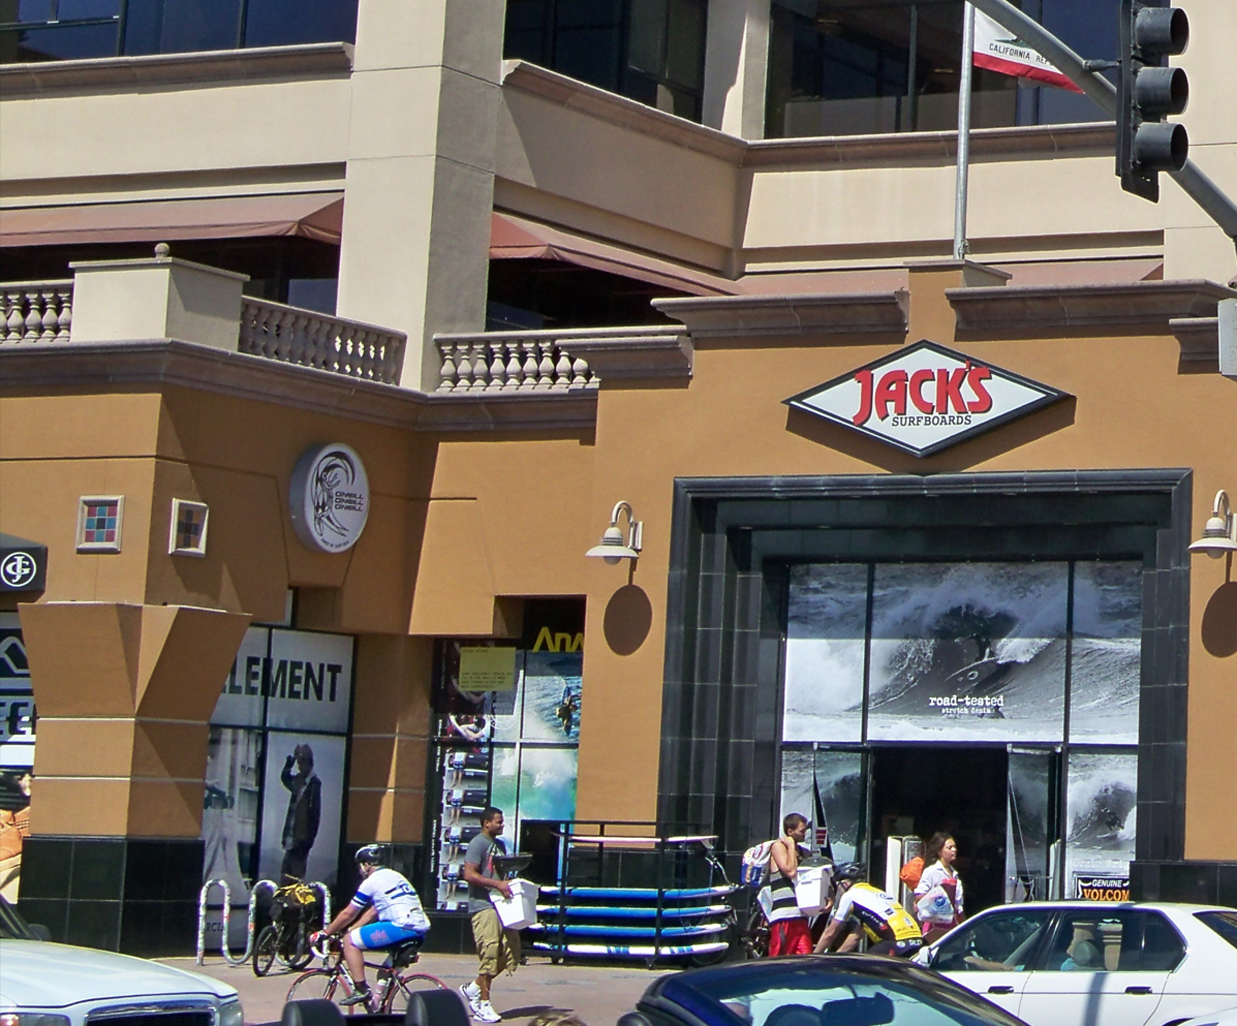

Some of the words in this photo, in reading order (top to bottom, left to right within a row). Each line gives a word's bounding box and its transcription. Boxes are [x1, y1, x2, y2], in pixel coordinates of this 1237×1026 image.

[989, 43, 1030, 60] CALIFORNIA
[852, 360, 994, 427] JACK'S
[892, 415, 972, 427] SURFBOARDS
[221, 655, 342, 703] LEMENT
[929, 695, 1004, 707] road-tested
[1092, 879, 1122, 887] GENUINE
